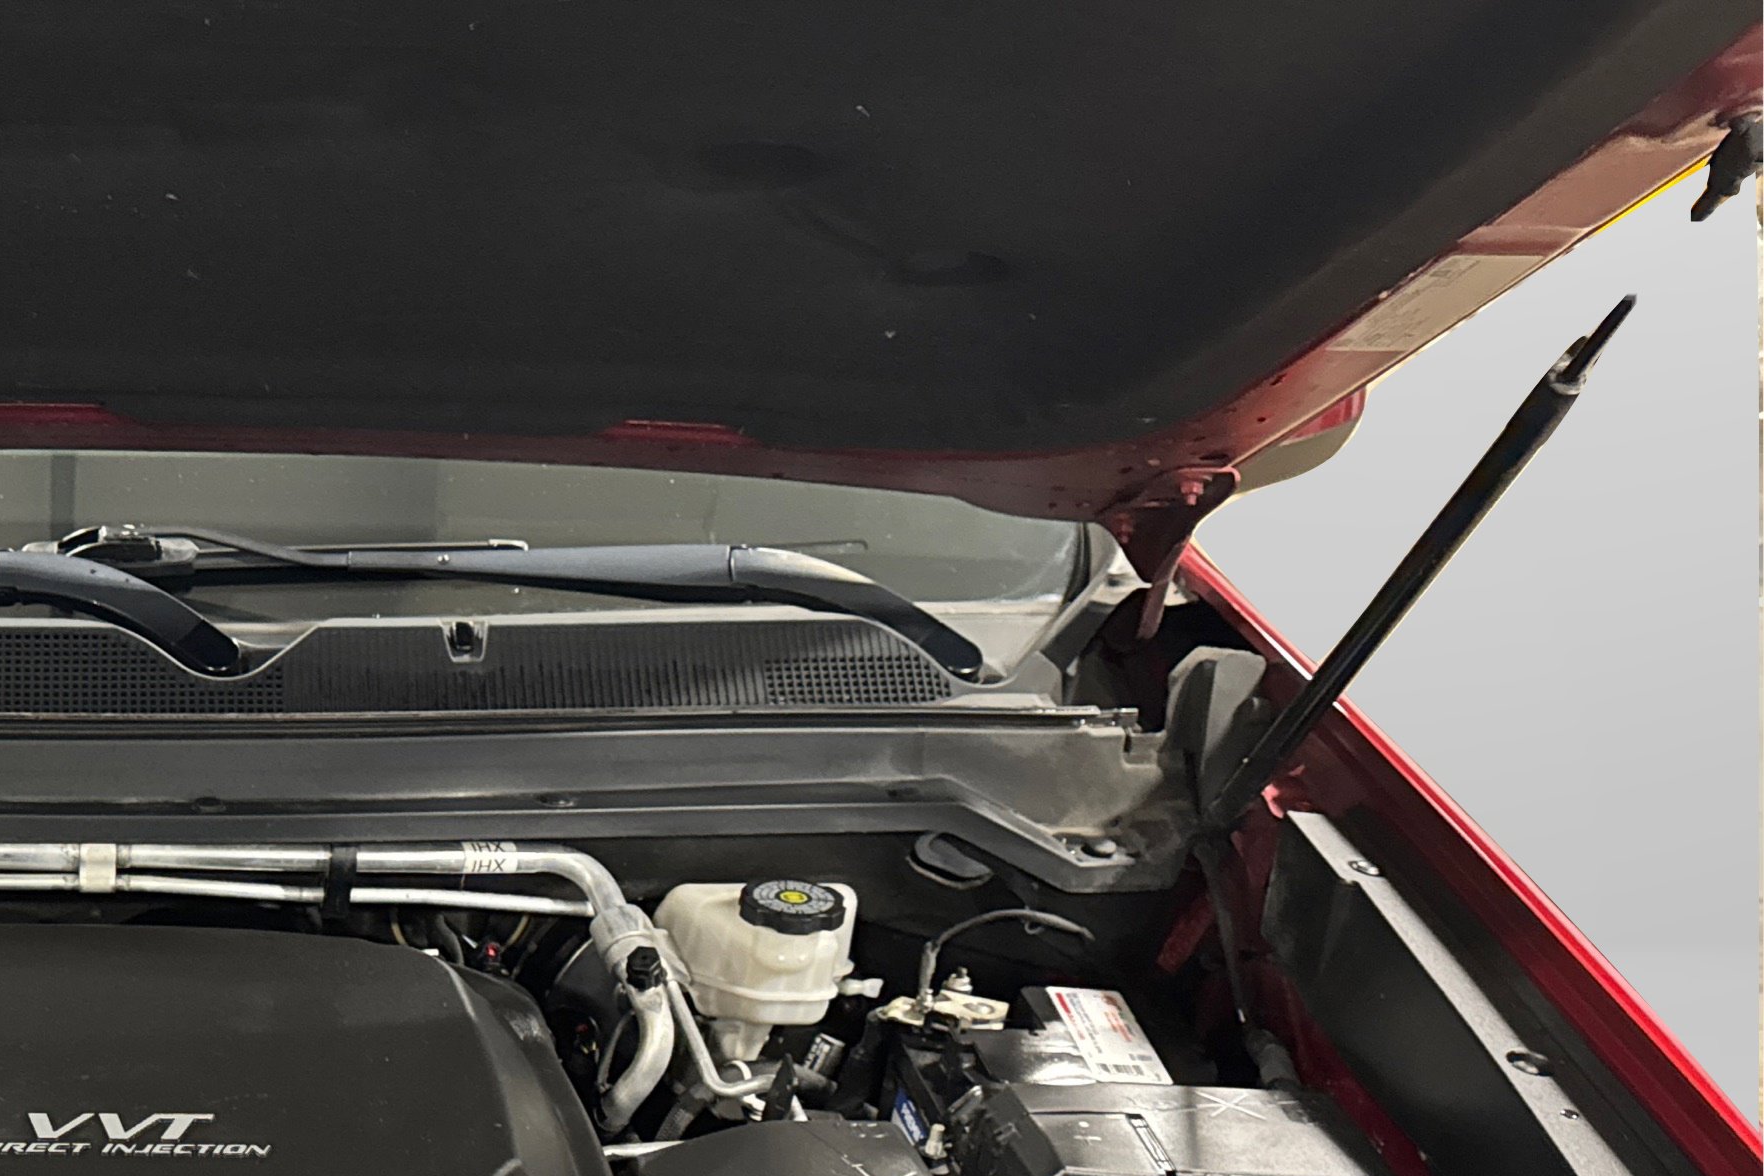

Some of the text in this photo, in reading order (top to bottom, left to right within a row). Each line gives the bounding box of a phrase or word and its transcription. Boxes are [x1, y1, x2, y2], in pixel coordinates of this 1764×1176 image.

[471, 858, 506, 872] IHX
[28, 1111, 216, 1141] VVT
[101, 1142, 272, 1157] INJECTION
